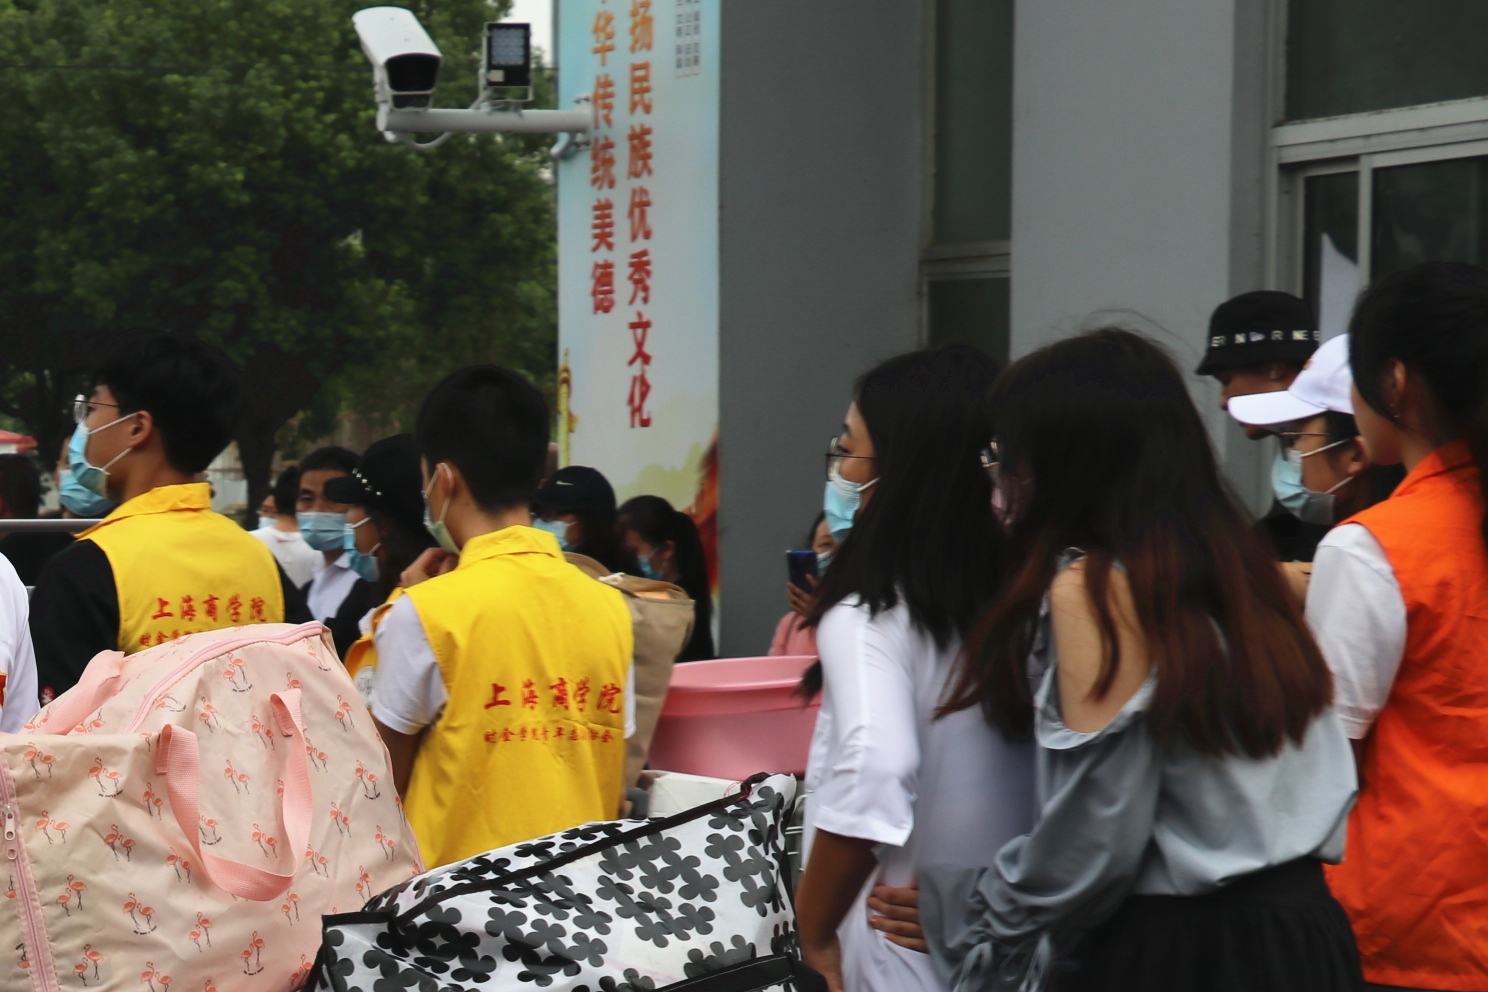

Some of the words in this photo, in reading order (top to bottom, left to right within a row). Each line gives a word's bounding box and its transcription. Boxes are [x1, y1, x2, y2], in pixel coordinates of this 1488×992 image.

[591, 0, 616, 314] 华传统美德
[484, 677, 622, 714] 上海商学院
